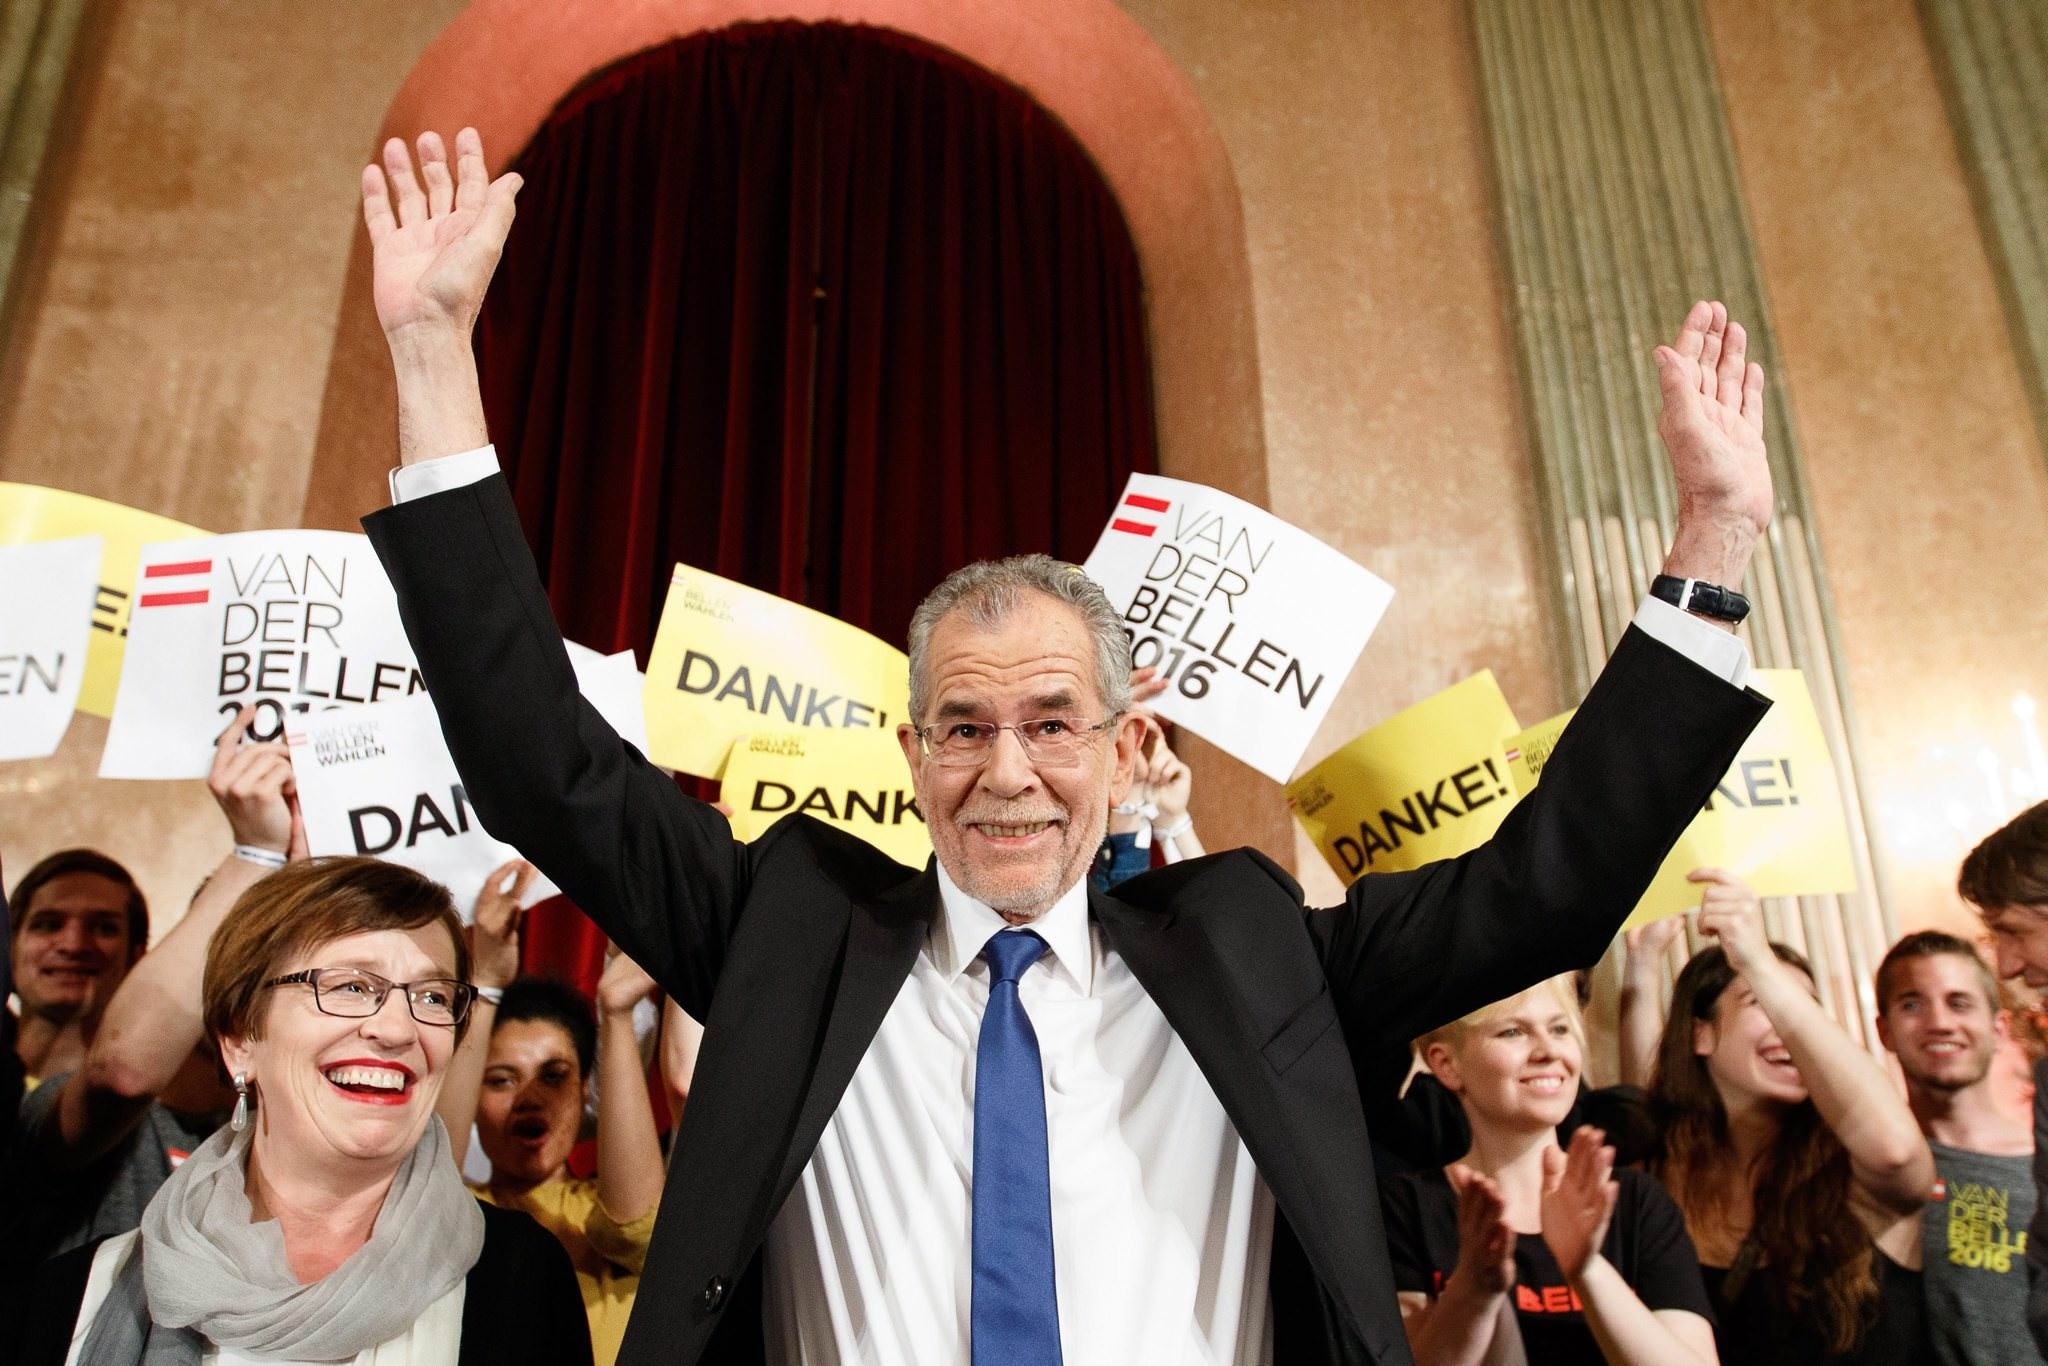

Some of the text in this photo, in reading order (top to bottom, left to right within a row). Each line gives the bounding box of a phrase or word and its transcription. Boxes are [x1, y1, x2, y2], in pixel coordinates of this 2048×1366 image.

[1174, 502, 1275, 575] VAN
[227, 552, 347, 599] VAN
[1144, 543, 1249, 614] DER
[222, 600, 343, 649] DER
[1124, 584, 1325, 710] BELLEN
[214, 698, 343, 747] 20
[1333, 757, 1508, 876] DANKE!
[1948, 1180, 2009, 1209] VAN
[1948, 1199, 2008, 1228] DER
[1948, 1245, 2012, 1274] 2016
